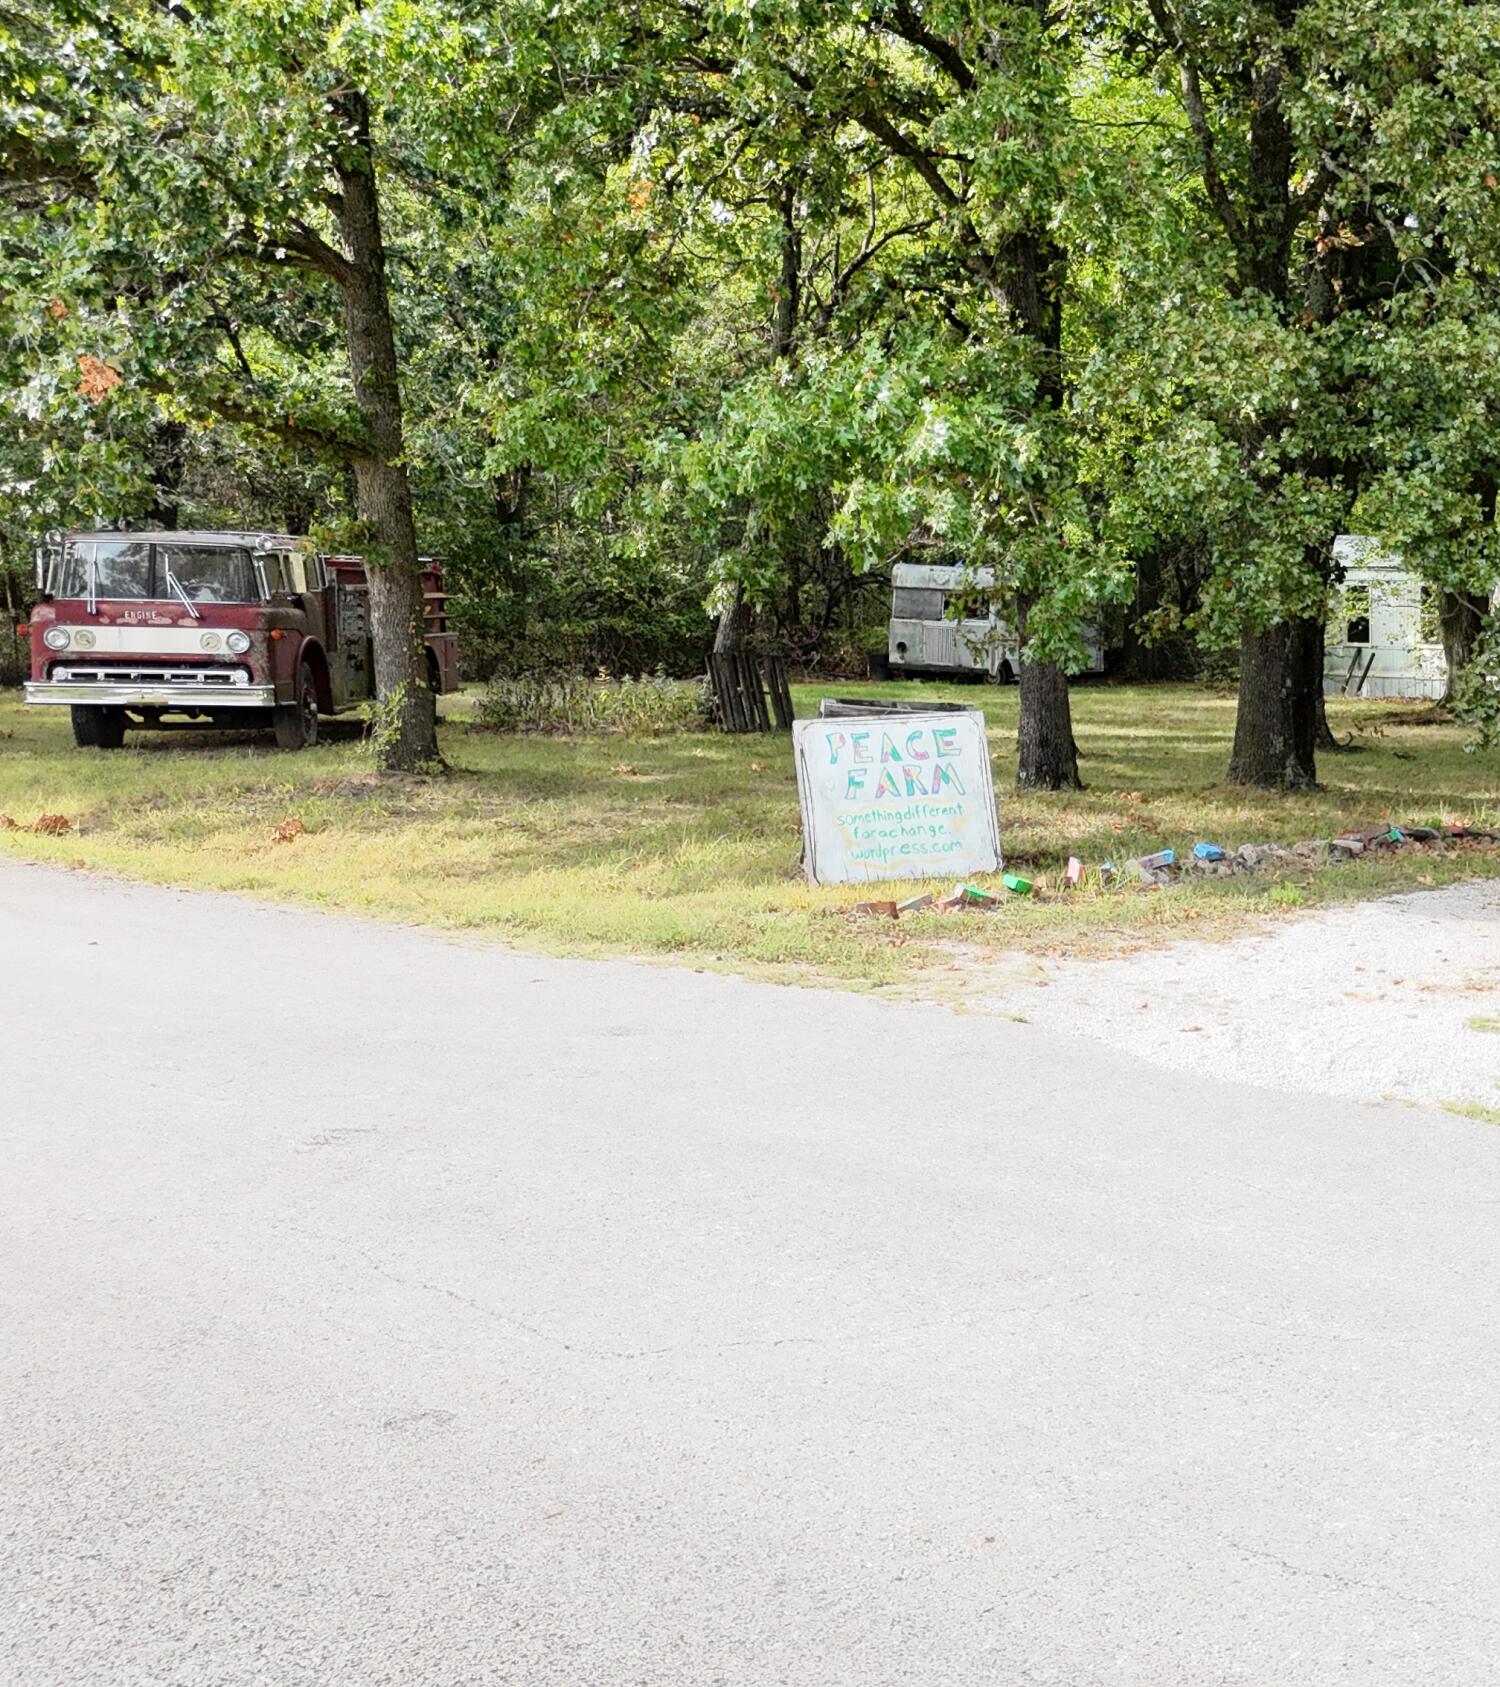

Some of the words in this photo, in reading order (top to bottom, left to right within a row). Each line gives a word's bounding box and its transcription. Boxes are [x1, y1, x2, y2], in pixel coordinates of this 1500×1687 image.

[124, 610, 158, 620] ENGINE
[825, 728, 962, 765] PEACE
[844, 762, 966, 800] FARM
[850, 840, 963, 863] wordpress.com
